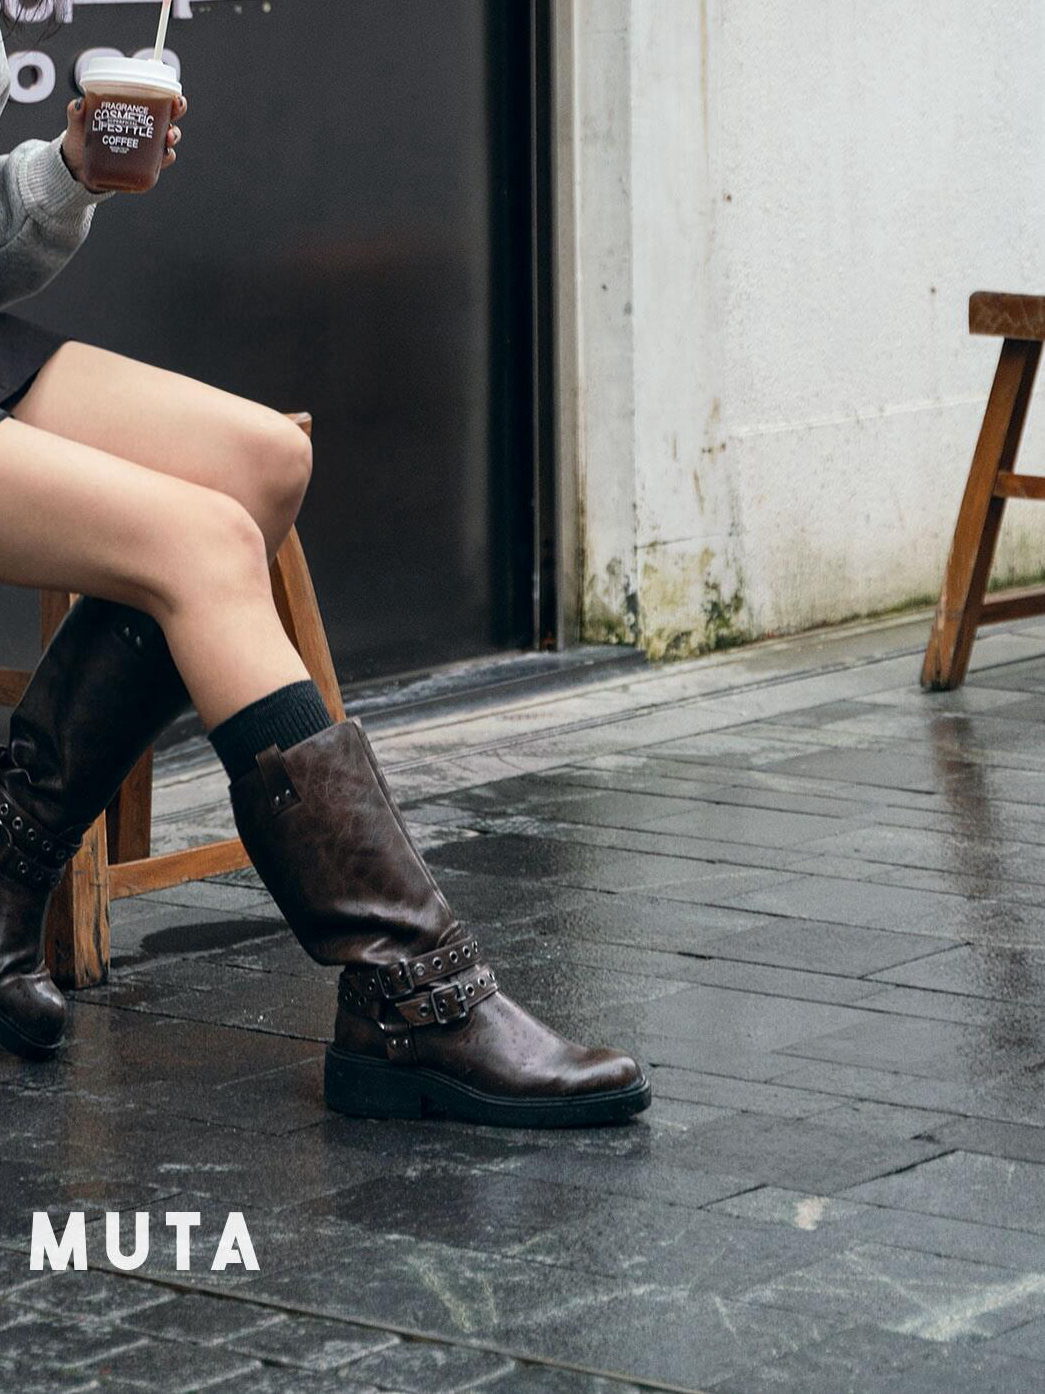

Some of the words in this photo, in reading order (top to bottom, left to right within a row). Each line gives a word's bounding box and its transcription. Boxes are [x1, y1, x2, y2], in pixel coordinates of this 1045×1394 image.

[100, 101, 150, 115] FRAGRANCE
[94, 109, 154, 127] COSMETIC
[91, 119, 155, 139] LIFESTYLE
[102, 135, 139, 149] COFFEE
